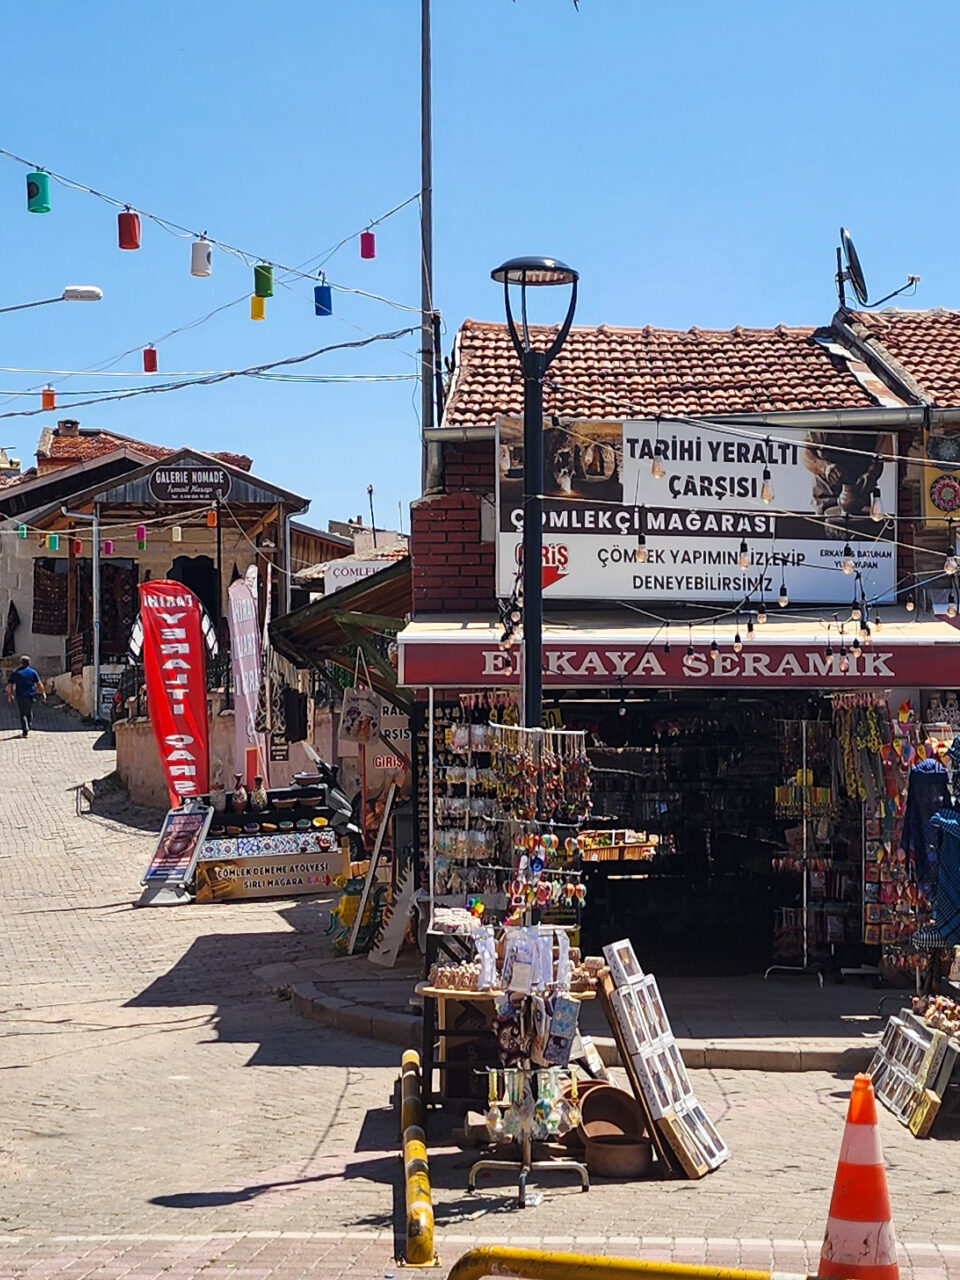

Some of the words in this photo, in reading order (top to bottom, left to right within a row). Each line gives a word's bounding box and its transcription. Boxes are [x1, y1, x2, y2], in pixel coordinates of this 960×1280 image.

[626, 435, 702, 462] TARİHİ
[708, 440, 798, 465] YERALTI
[155, 471, 189, 484] GALERIE
[191, 471, 225, 483] NOMADE
[668, 474, 758, 501] ÇARŞISI
[510, 507, 640, 535] ÇMLEKÇİ
[647, 509, 774, 533] MAĞARASI
[597, 545, 665, 567] ÇÖMEK
[670, 549, 741, 566] YAPIMIN
[820, 549, 847, 557] ERKAY
[632, 572, 774, 593] DENEYEBİLİRSİNİZ
[481, 651, 667, 676] EKAYA
[253, 865, 287, 876] DENEME
[267, 877, 303, 887] MAĞARA
